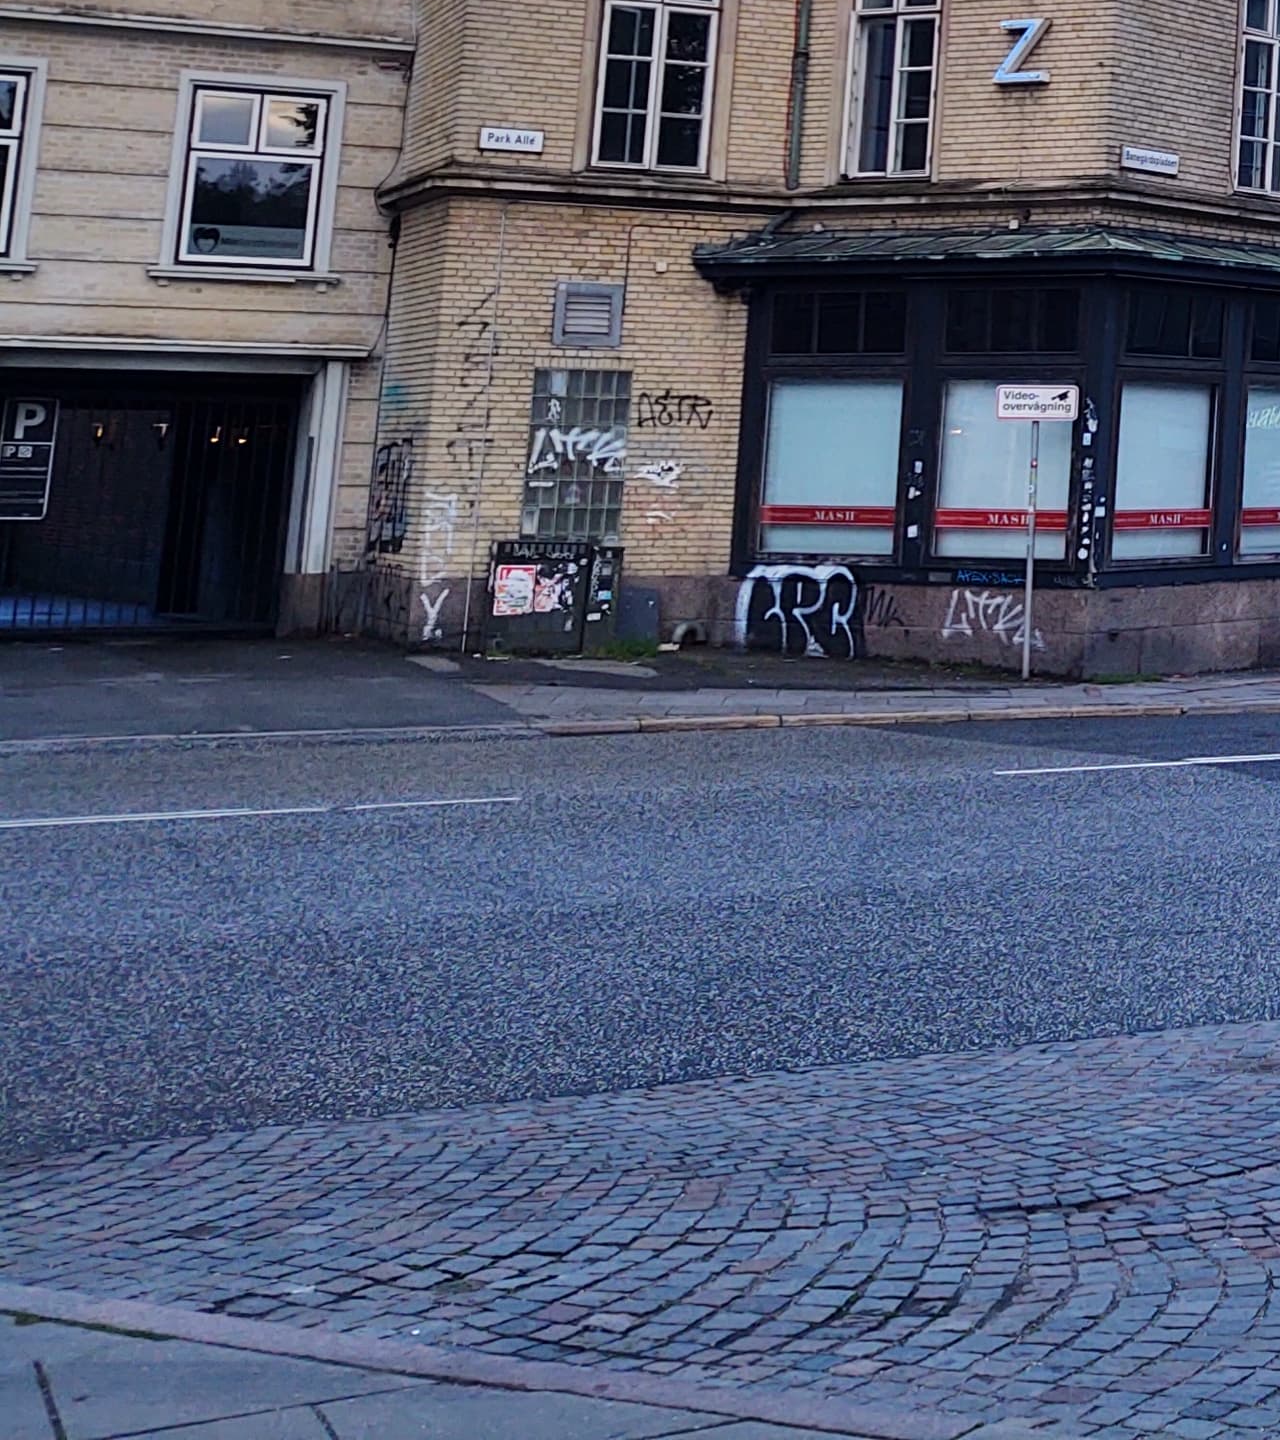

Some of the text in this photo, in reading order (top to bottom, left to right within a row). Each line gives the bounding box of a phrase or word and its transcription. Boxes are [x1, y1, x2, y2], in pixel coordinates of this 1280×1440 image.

[487, 132, 511, 144] Park
[1004, 391, 1040, 400] Video-
[1003, 401, 1072, 413] overvågning
[14, 402, 46, 439] P
[814, 511, 855, 521] MASH
[988, 514, 1030, 525] MASH
[1150, 512, 1182, 525] MASH
